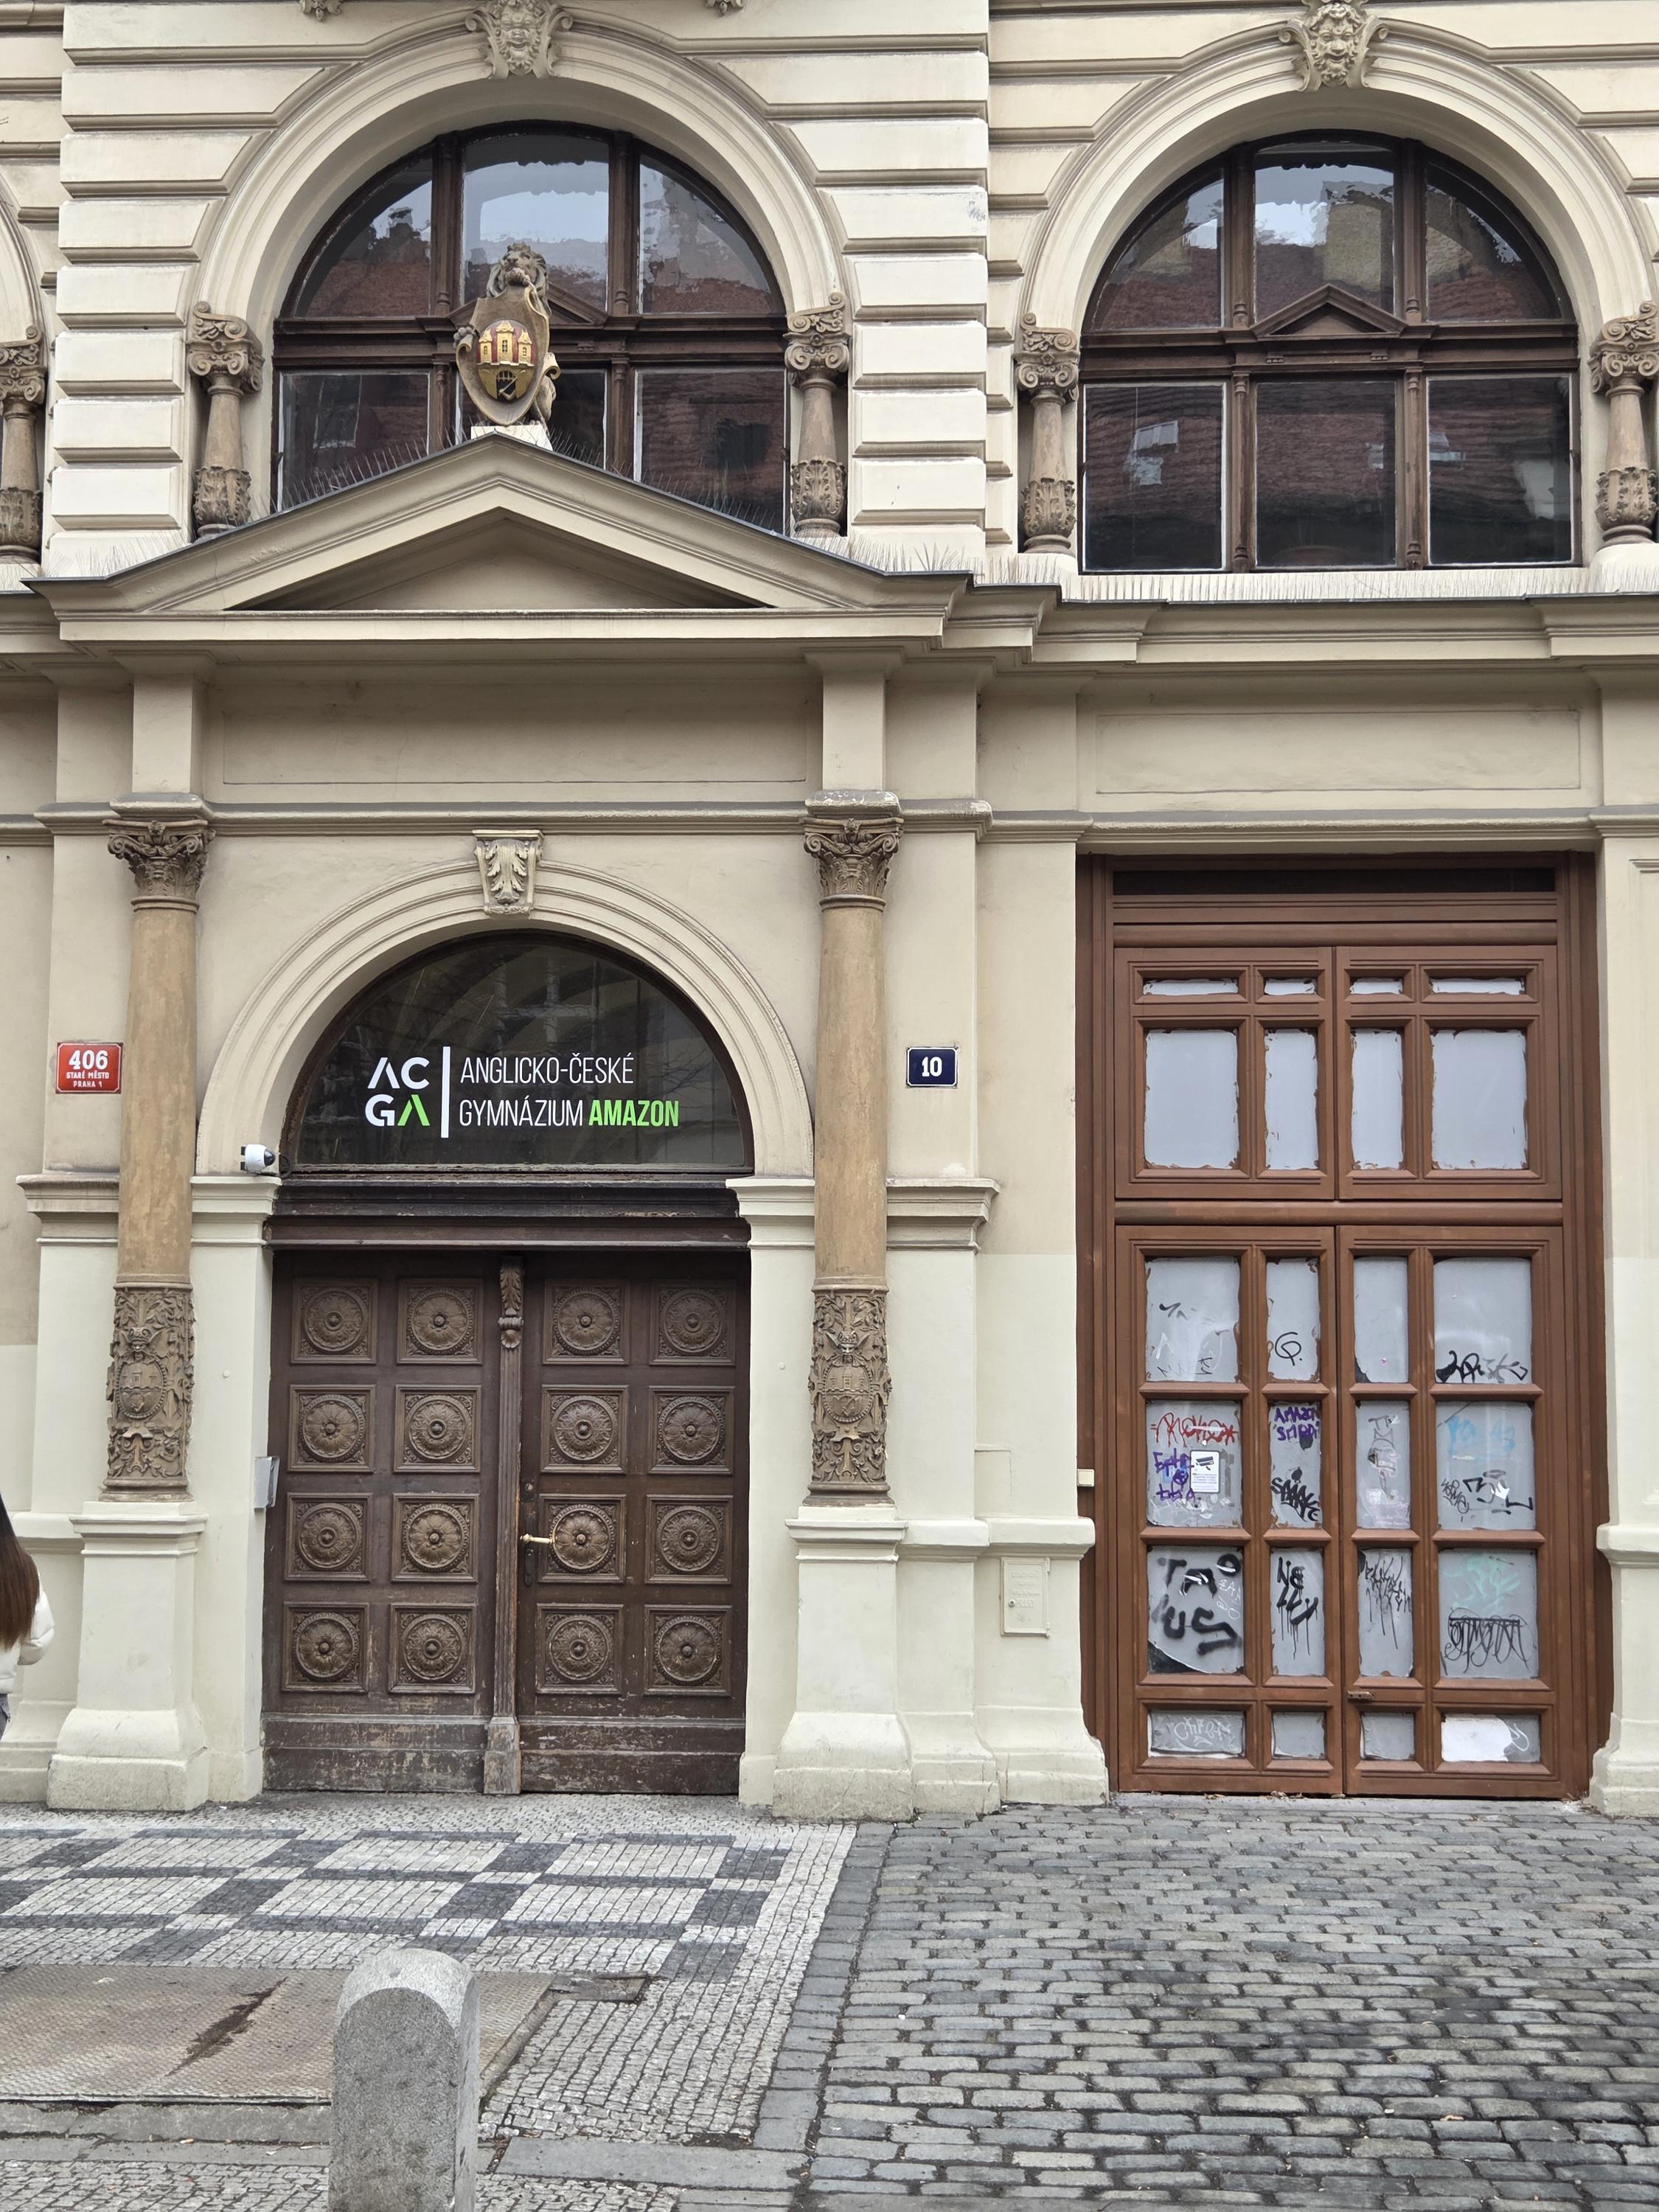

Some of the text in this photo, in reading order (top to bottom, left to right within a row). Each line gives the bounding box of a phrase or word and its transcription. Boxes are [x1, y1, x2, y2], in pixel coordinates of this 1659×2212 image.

[69, 1050, 108, 1070] 406
[460, 1052, 634, 1084] ANGLICKO-ČESKÉ
[922, 1057, 942, 1077] 10
[66, 1070, 109, 1079] STARÉ MĚSTO
[459, 1095, 679, 1127] GYMNÁZIUM AMAZON
